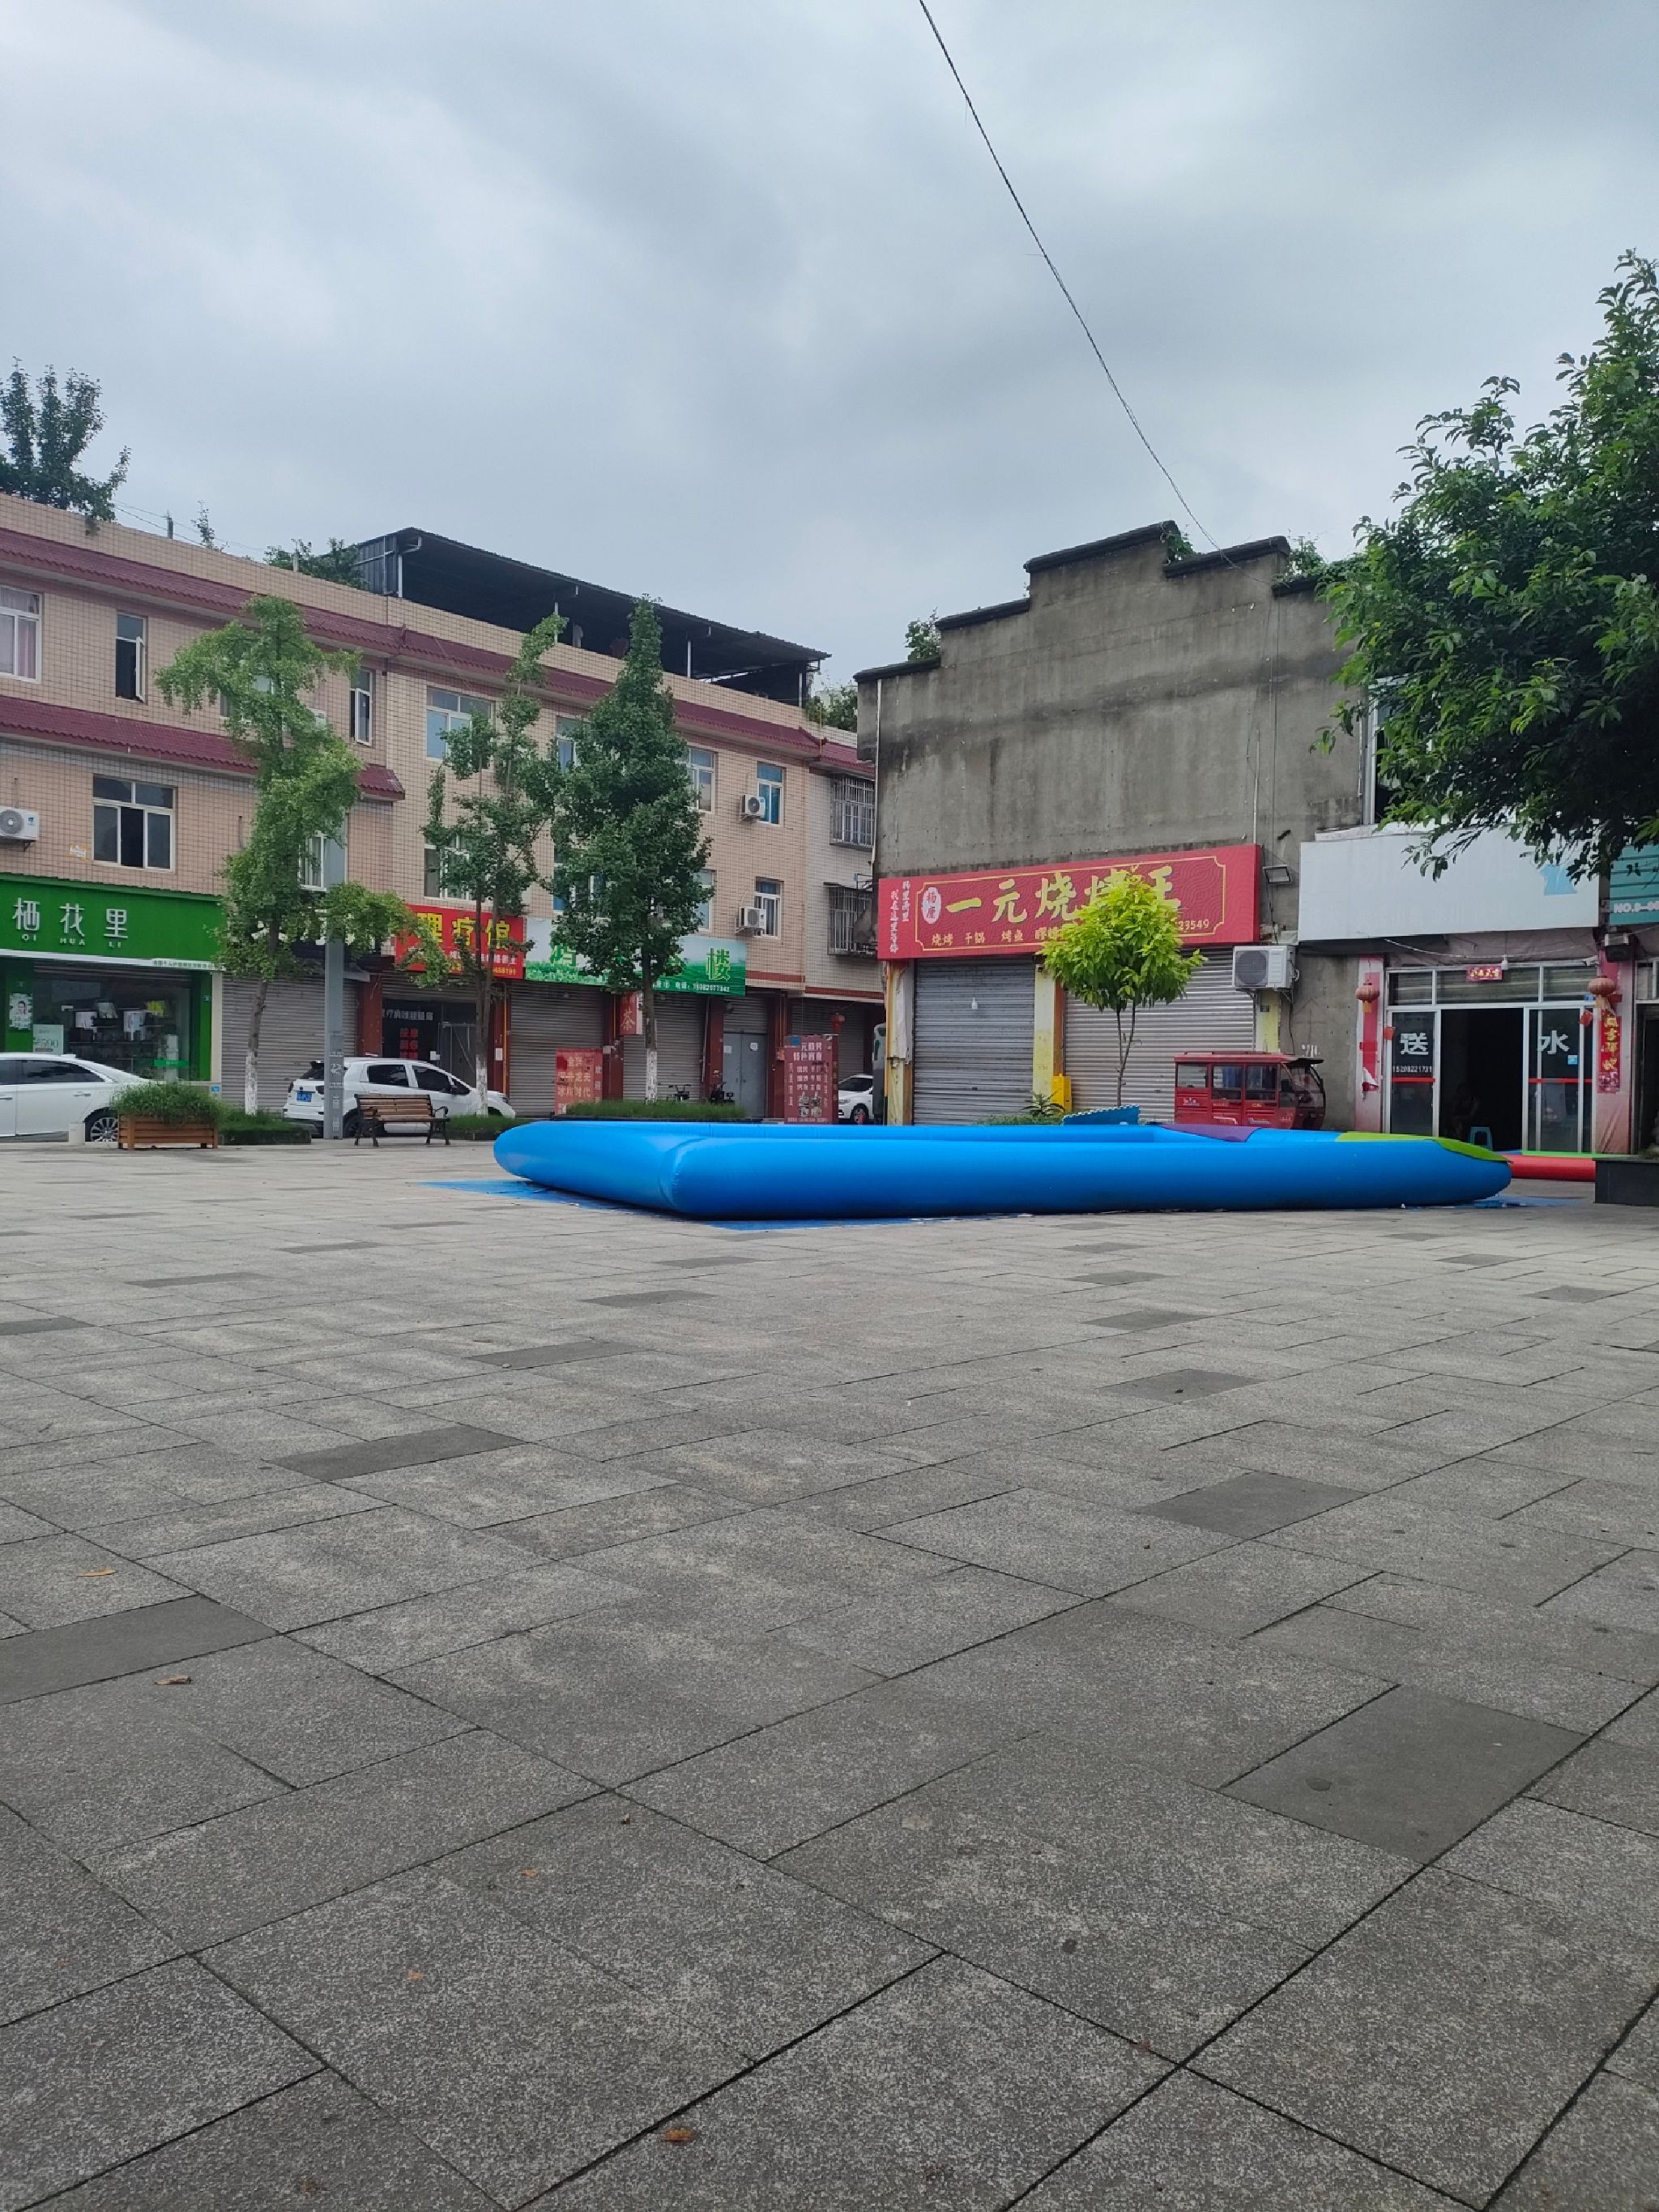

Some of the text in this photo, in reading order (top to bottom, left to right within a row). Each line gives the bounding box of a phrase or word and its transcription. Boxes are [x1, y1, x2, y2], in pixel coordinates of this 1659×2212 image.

[59, 937, 86, 946] HUA
[1400, 1030, 1570, 1055] 送 水
